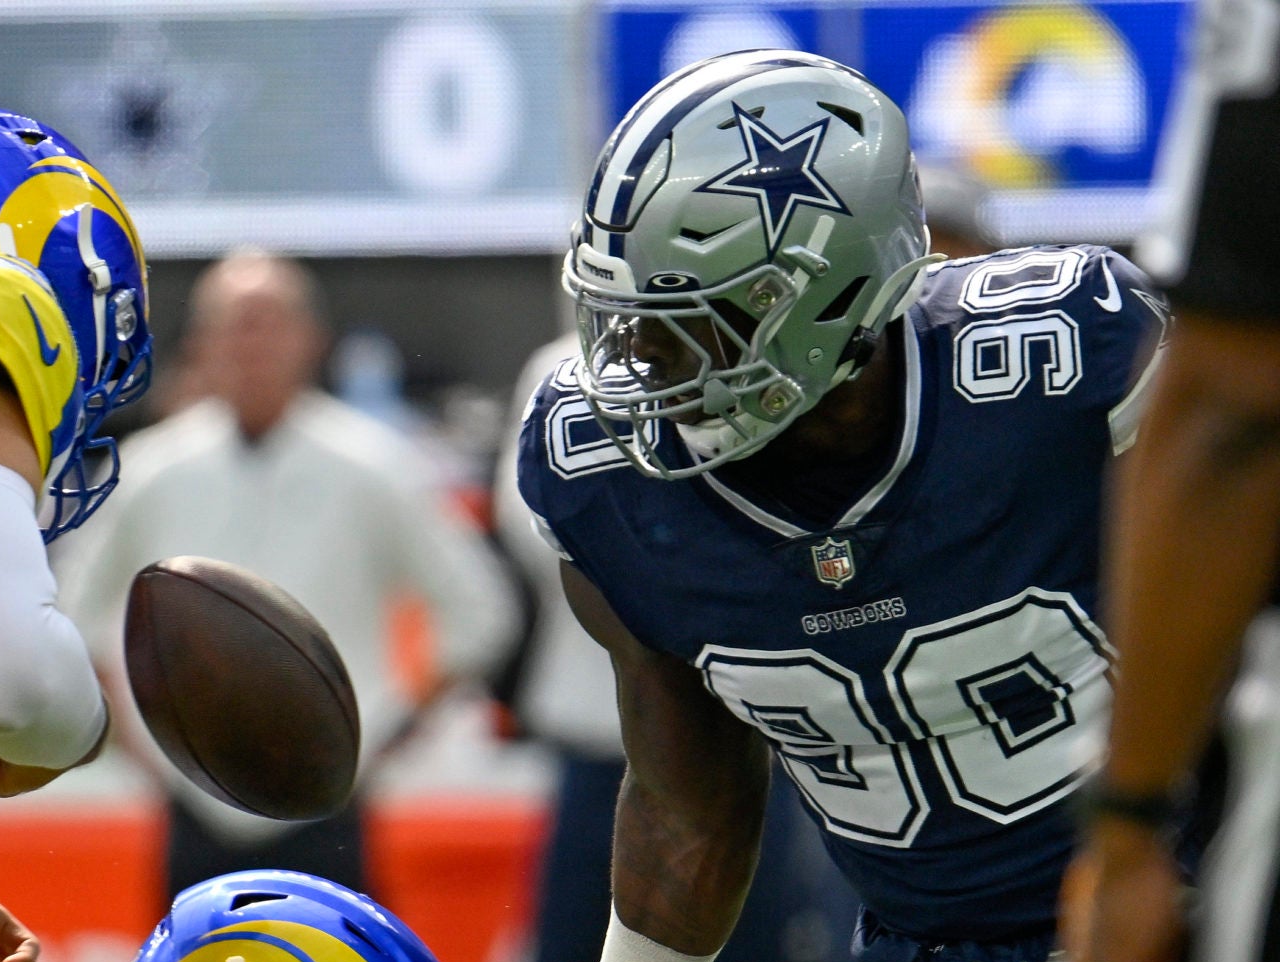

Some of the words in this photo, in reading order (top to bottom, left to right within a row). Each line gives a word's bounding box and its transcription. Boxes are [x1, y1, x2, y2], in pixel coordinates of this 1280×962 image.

[372, 8, 518, 194] 0
[952, 249, 1089, 404] 90
[801, 596, 907, 635] COWBOYS
[694, 586, 1119, 849] 90
